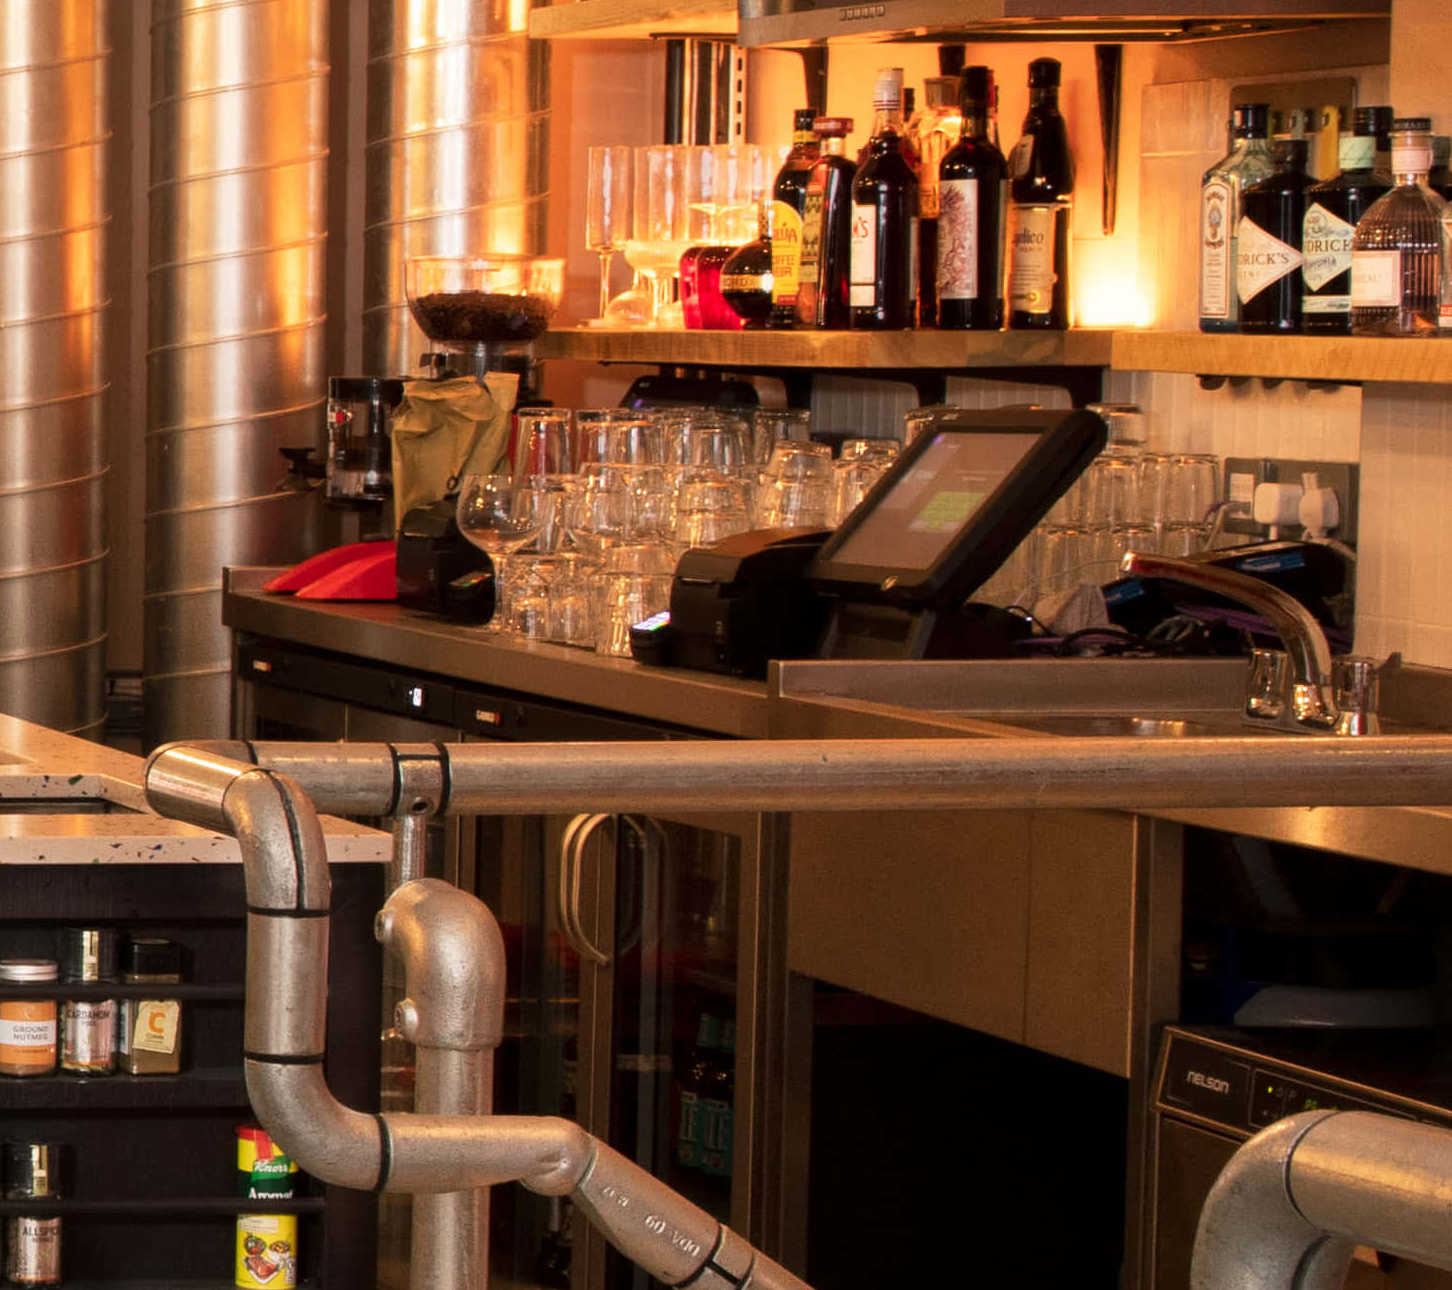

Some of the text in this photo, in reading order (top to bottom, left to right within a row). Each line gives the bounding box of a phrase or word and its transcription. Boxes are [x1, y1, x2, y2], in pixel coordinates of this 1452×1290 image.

[148, 1012, 166, 1034] C
[12, 1026, 48, 1034] GROUND
[13, 1033, 48, 1041] NUTMEG
[1186, 1070, 1231, 1094] NELSON
[254, 1160, 289, 1173] Knorr
